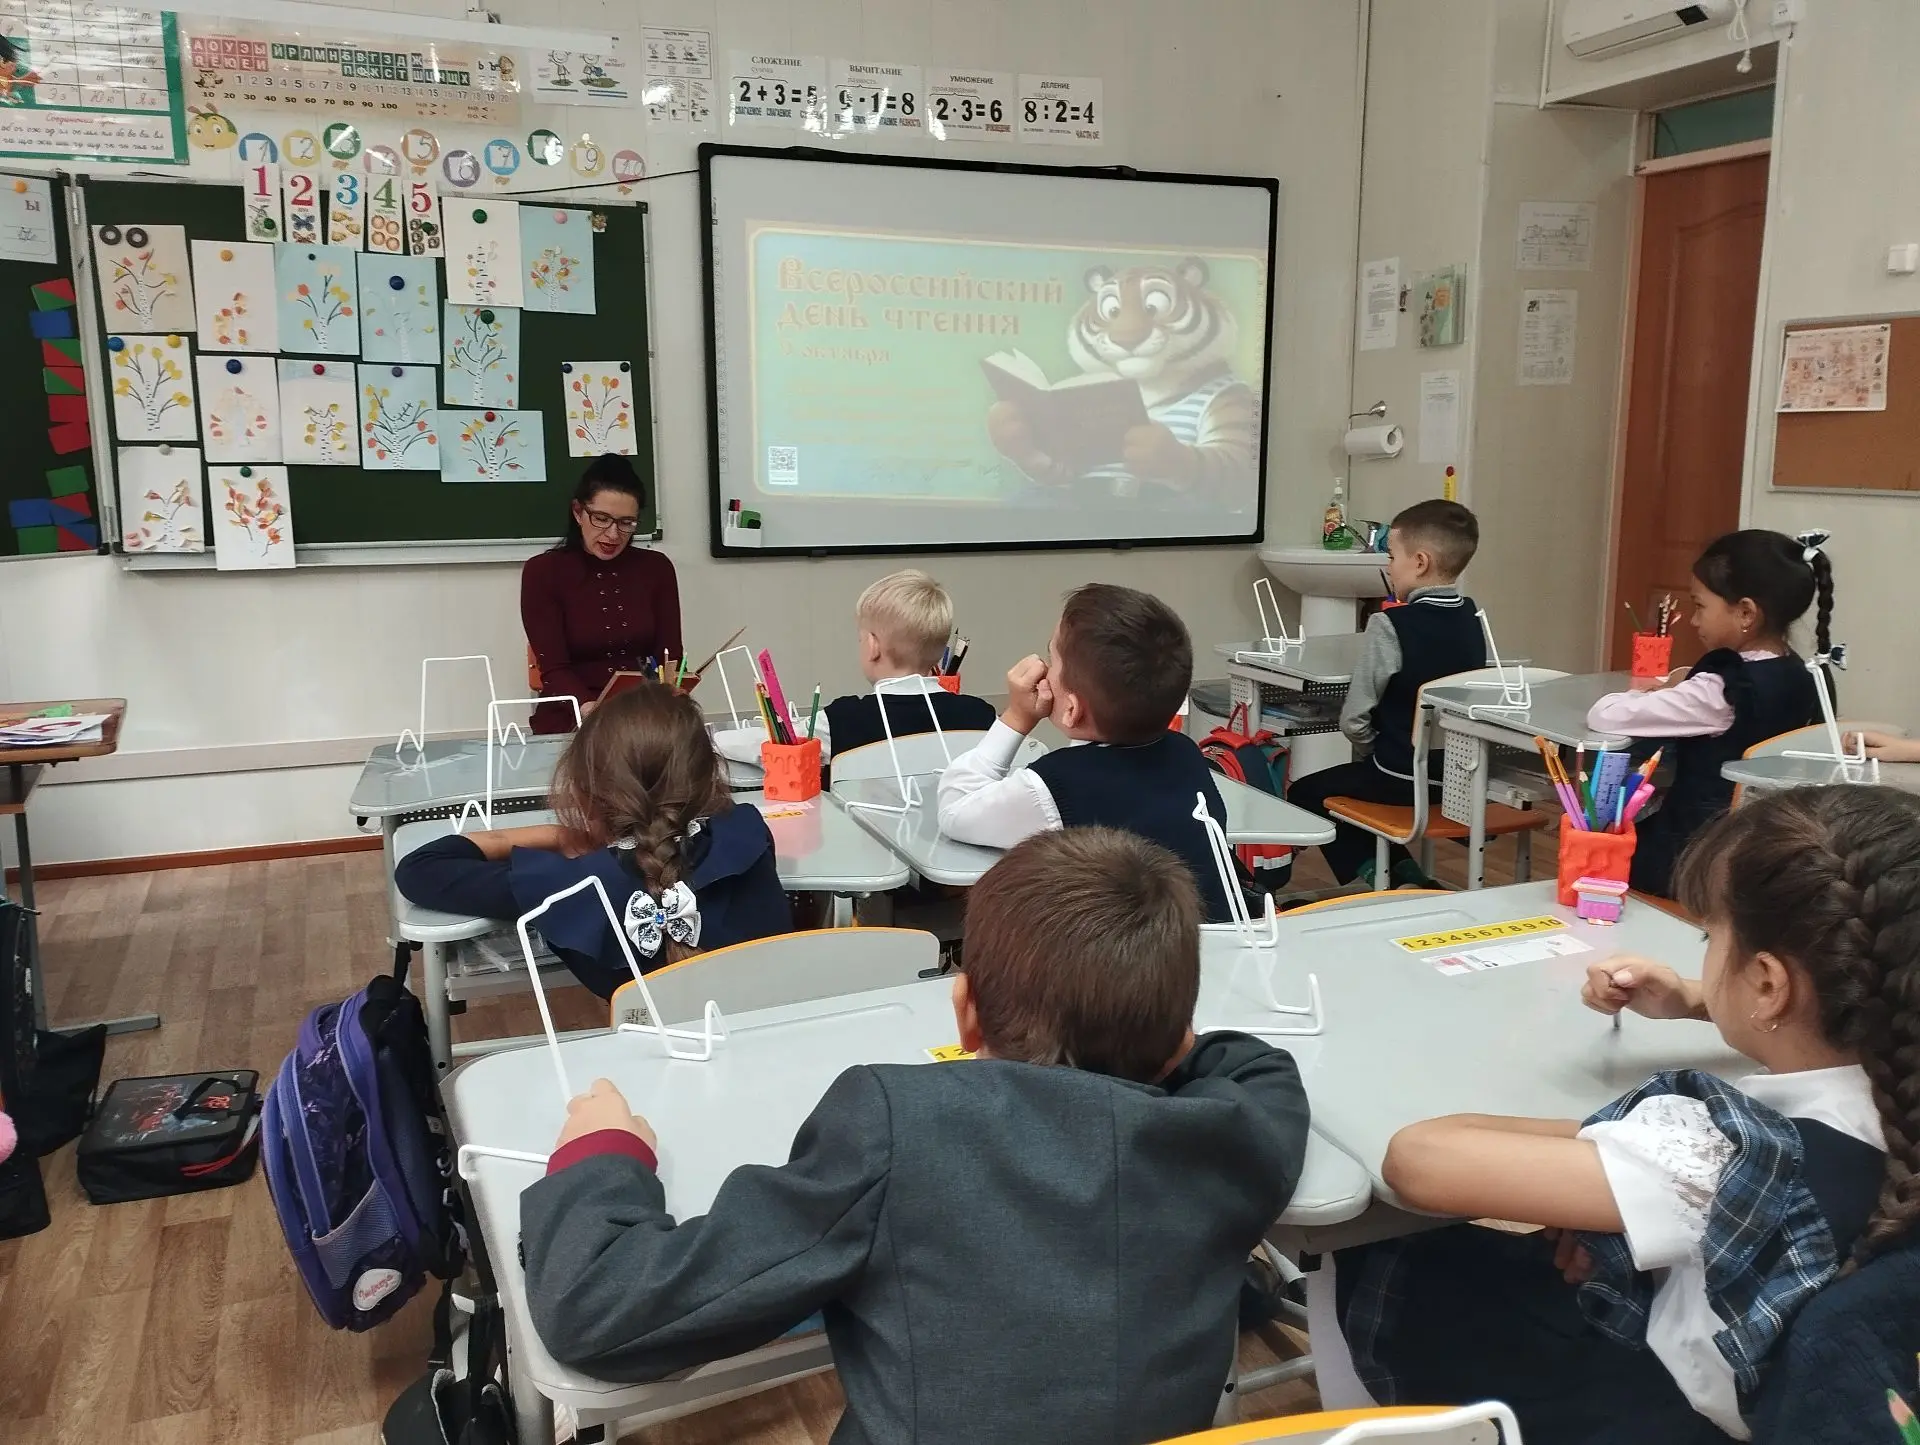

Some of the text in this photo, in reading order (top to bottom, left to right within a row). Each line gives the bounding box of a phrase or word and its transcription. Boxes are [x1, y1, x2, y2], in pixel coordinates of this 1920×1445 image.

[751, 56, 802, 67] СЛОЖЕНИЕ
[849, 64, 903, 76] ВЫЧИТАНИЕ
[950, 75, 994, 85] УМНОЖЕНИЕ
[1040, 81, 1071, 90] ДЕЛЕНИЕ
[243, 93, 256, 101] 30
[299, 137, 314, 160] 2
[416, 135, 434, 160] 5
[497, 146, 513, 166] 7
[584, 147, 598, 172] 9
[252, 165, 272, 196] 1
[290, 175, 313, 207] 2
[335, 174, 359, 206] 3
[373, 178, 397, 209] 4
[411, 181, 432, 213] 5
[777, 256, 1065, 305] Всероссийский
[1402, 941, 1412, 949] 1
[1417, 938, 1433, 947] 2
[1433, 936, 1447, 944] 3
[1450, 933, 1462, 941] 4
[1463, 931, 1477, 940] 5
[1478, 929, 1492, 937] 6
[1492, 927, 1505, 935] 7
[1523, 922, 1537, 930] 9
[1539, 918, 1563, 928] 10
